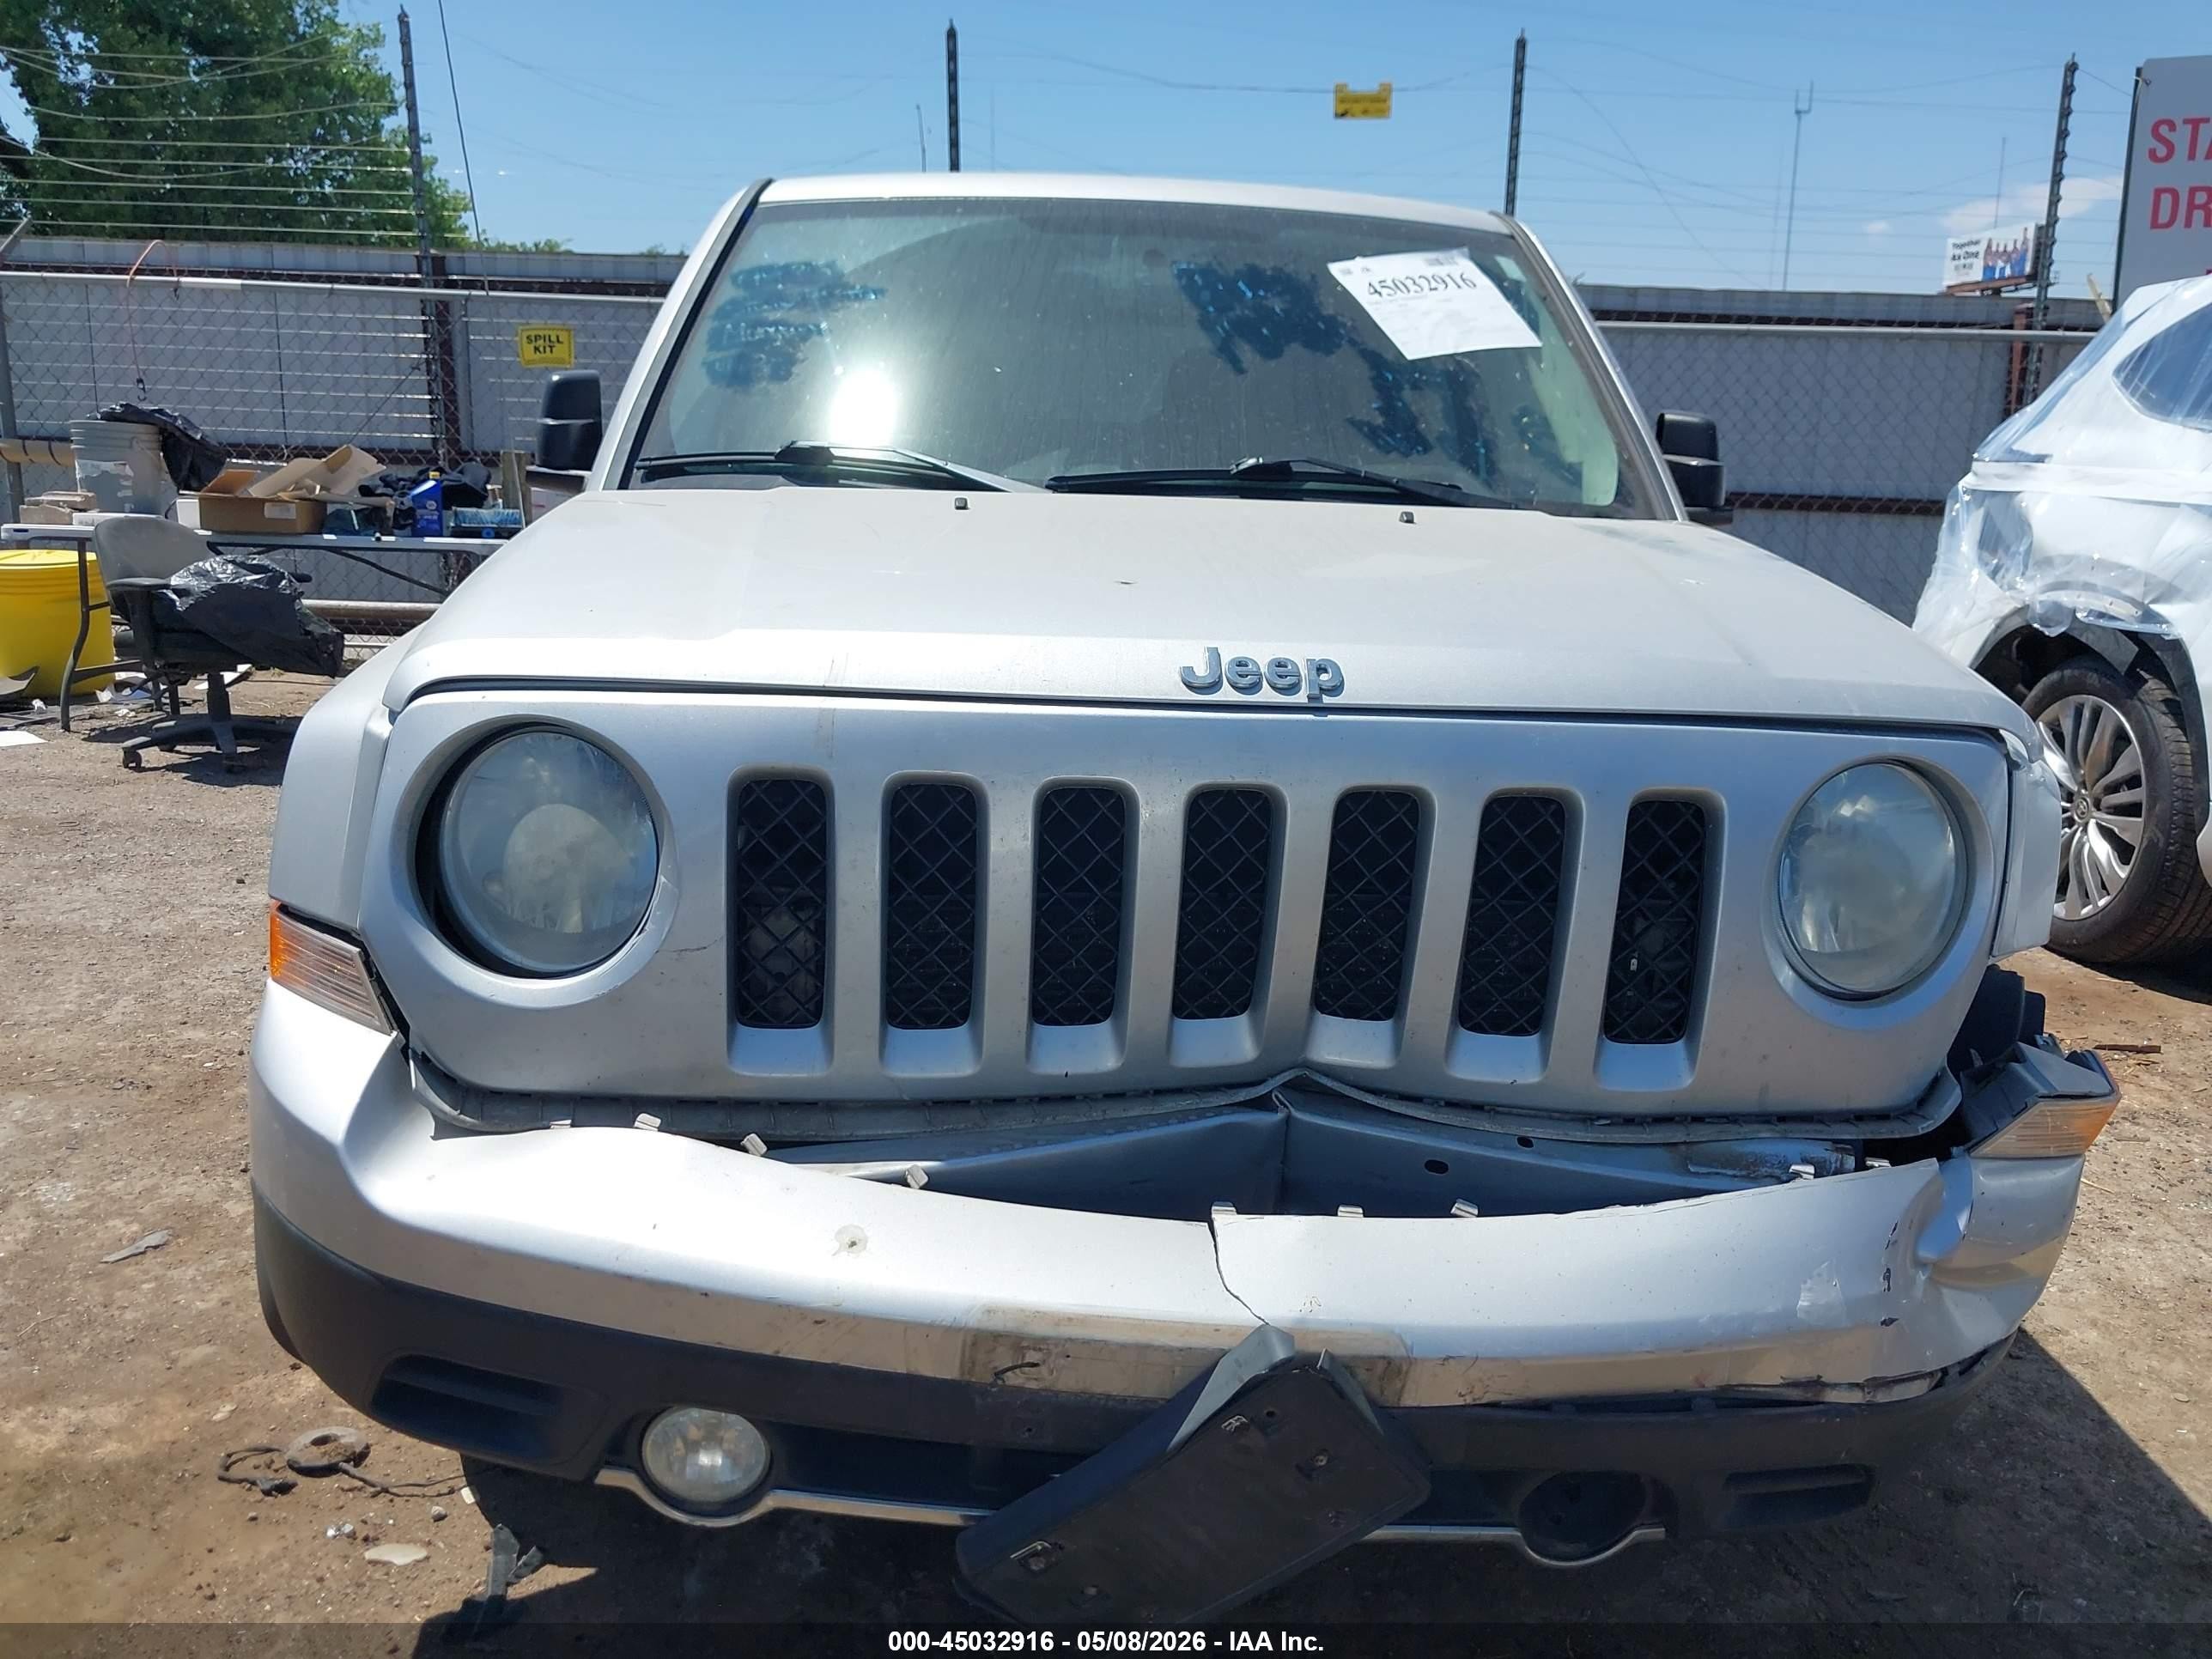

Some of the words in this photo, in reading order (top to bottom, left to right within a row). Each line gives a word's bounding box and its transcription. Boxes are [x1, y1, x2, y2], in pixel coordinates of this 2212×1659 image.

[2148, 118, 2212, 163] ST
[1367, 272, 1477, 298] 45032916
[526, 334, 564, 344] SPILL
[533, 345, 556, 355] KIT
[1180, 647, 1345, 702] Jeep
